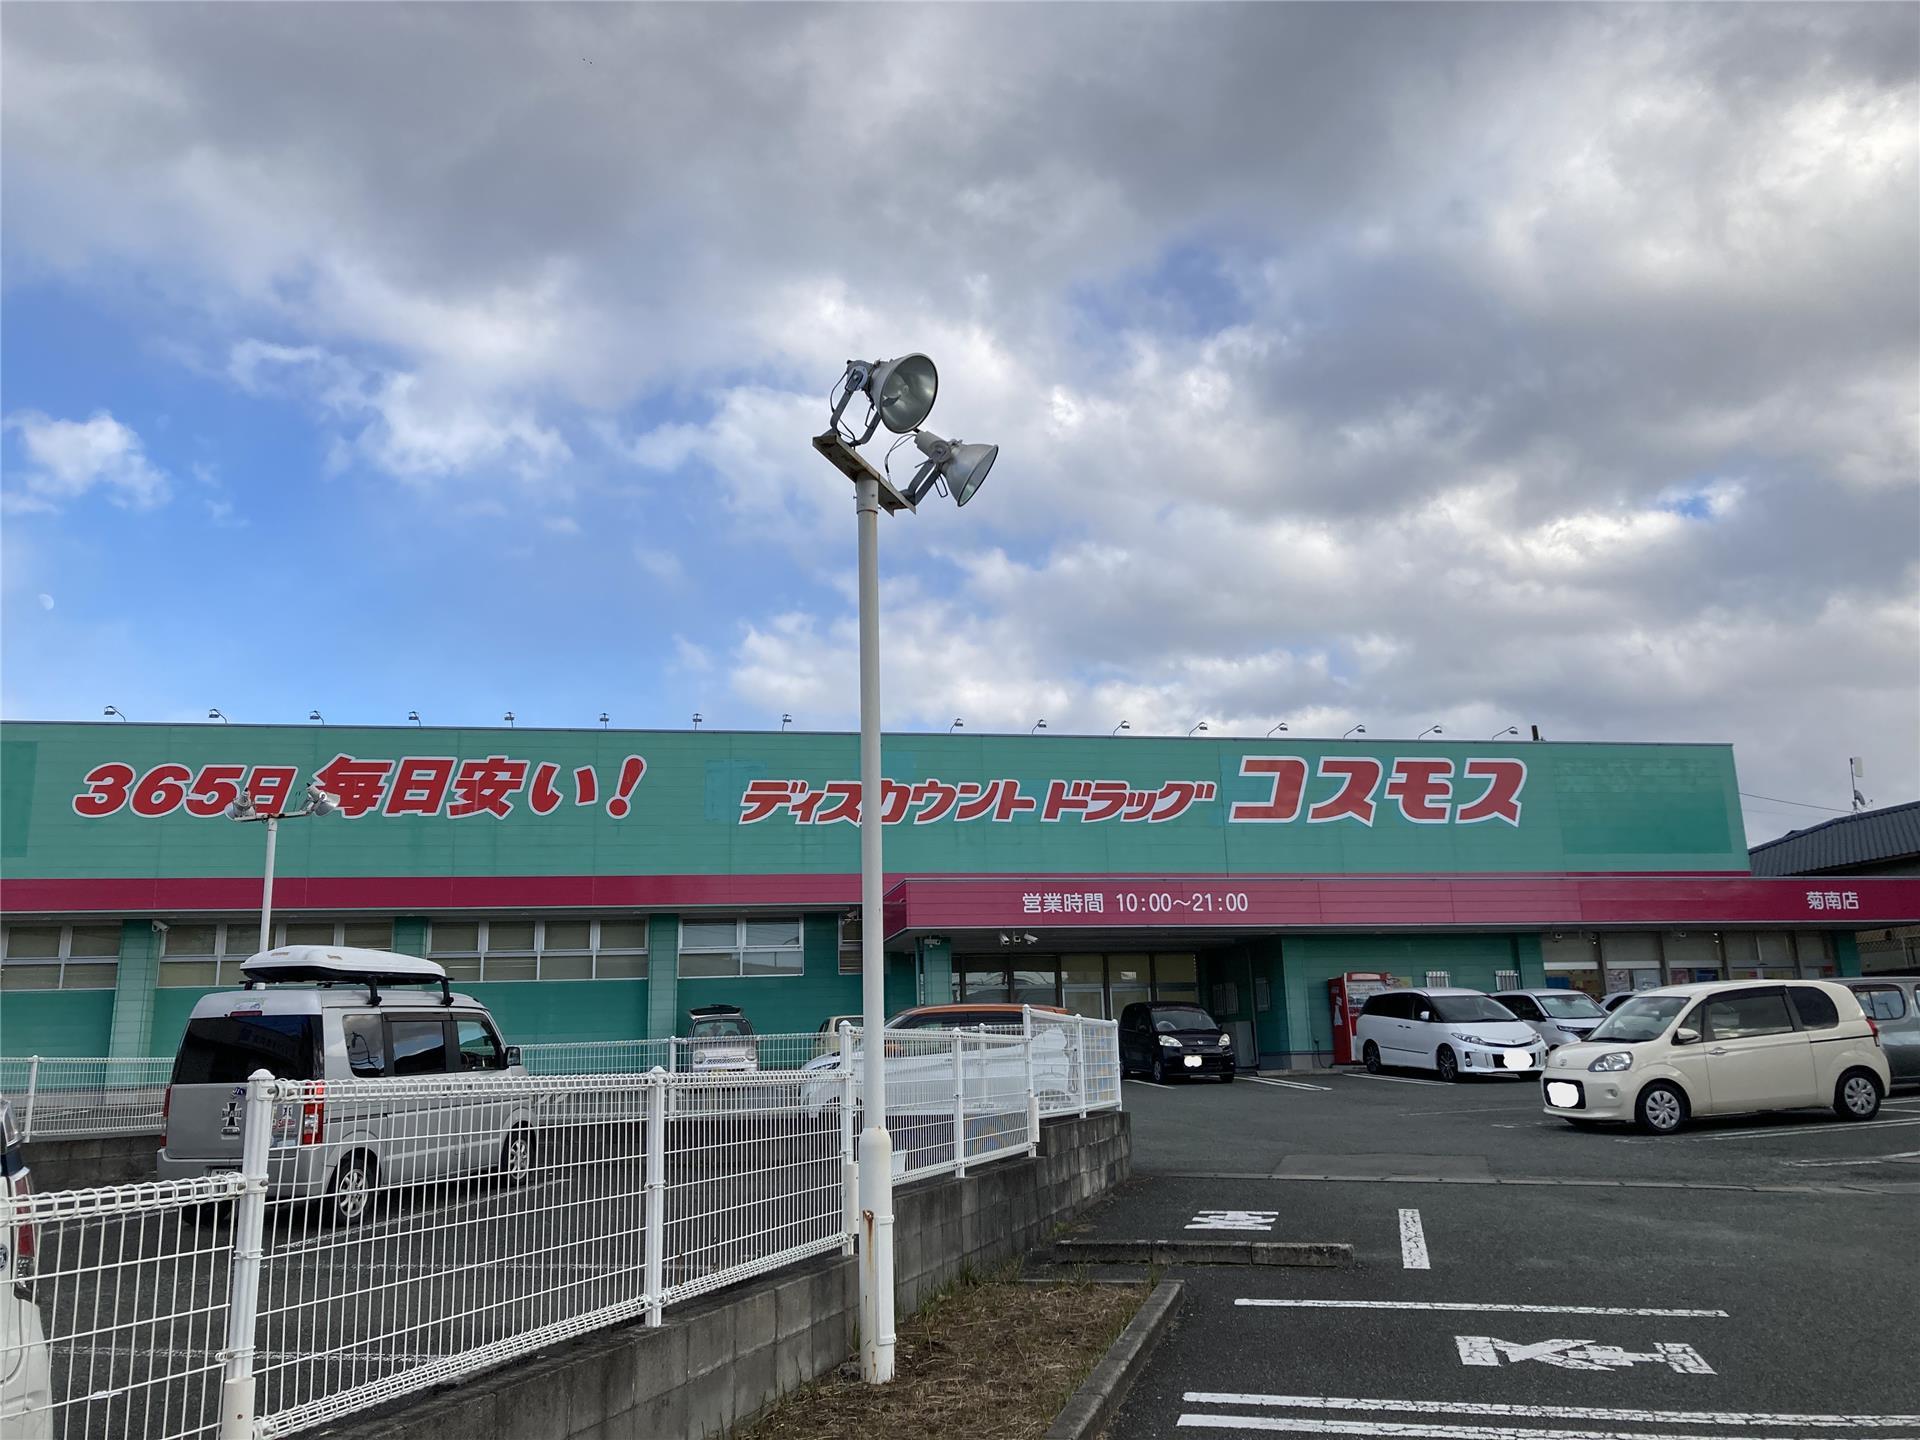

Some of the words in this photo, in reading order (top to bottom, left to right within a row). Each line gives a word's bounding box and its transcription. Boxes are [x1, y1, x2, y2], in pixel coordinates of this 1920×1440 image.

[738, 778, 1037, 827] ディスカウント
[1040, 779, 1217, 823] ドラッグ
[1228, 755, 1528, 828] コスモス
[1022, 892, 1105, 914] 営業時間
[1805, 891, 1860, 910] 菊南店
